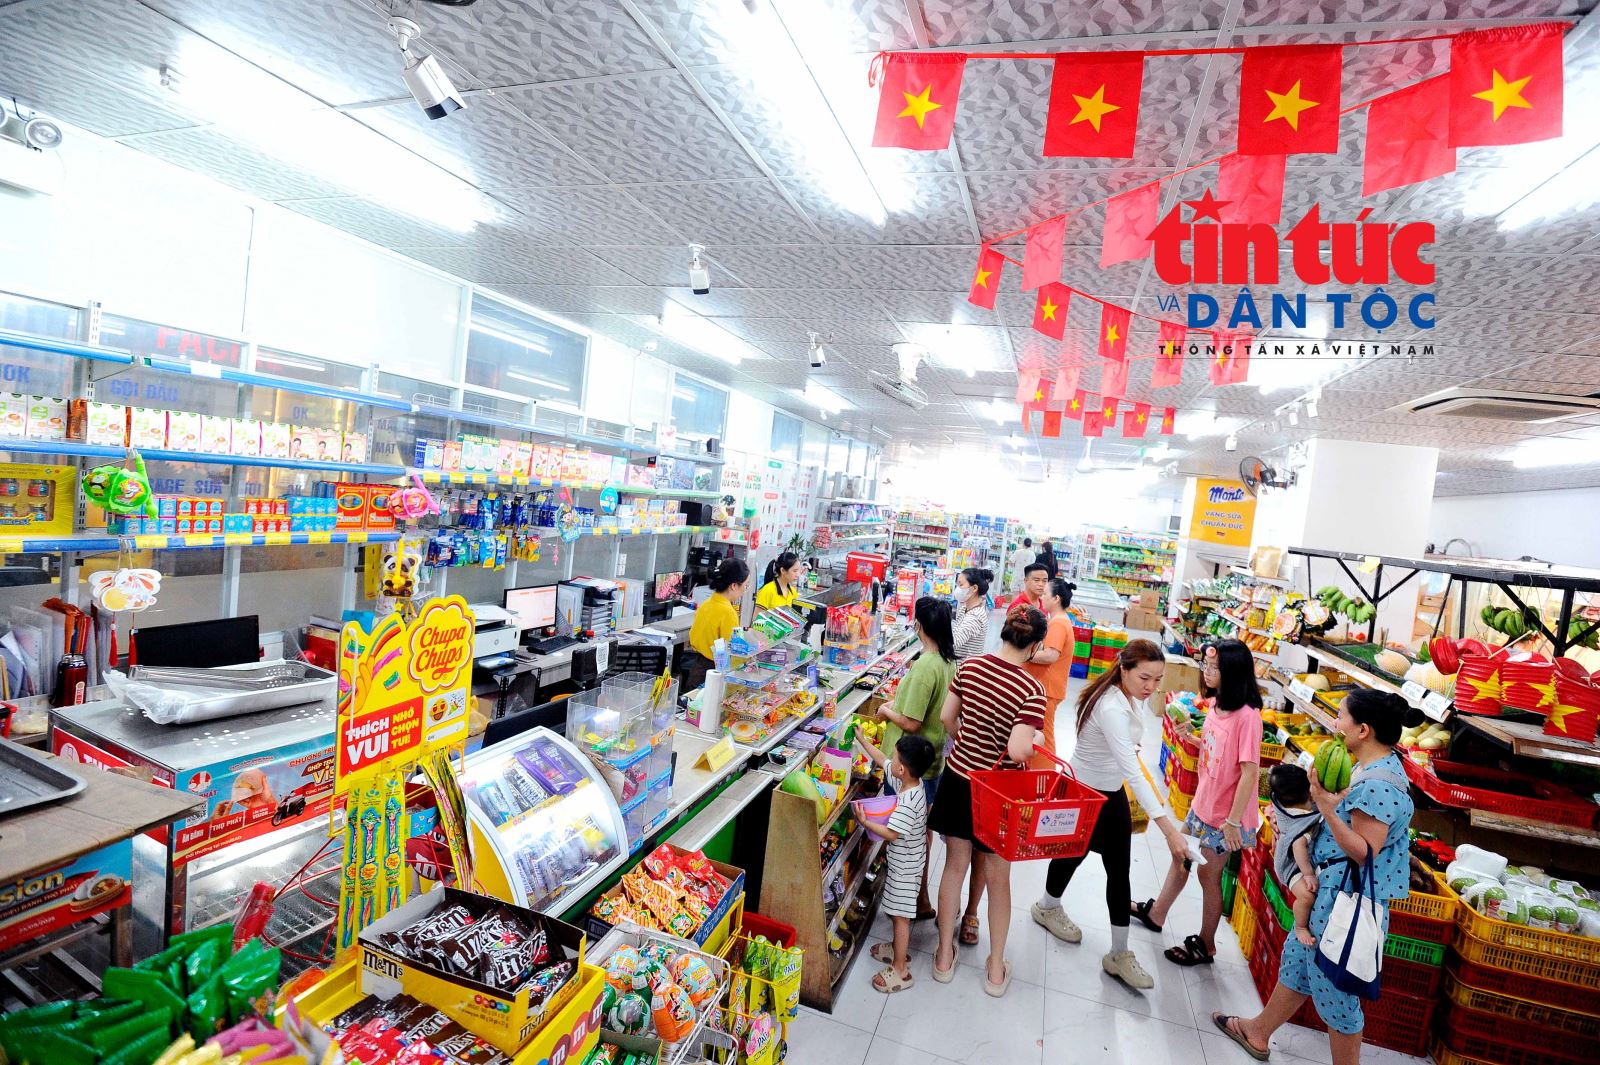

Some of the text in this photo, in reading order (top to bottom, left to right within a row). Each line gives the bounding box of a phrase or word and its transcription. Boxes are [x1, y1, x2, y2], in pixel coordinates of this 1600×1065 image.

[420, 625, 466, 648] Chupa
[416, 648, 463, 679] Chups
[346, 716, 389, 743] THÍCH
[391, 719, 419, 737] CHỌN
[347, 732, 389, 766] VUI
[391, 734, 410, 750] TUI!
